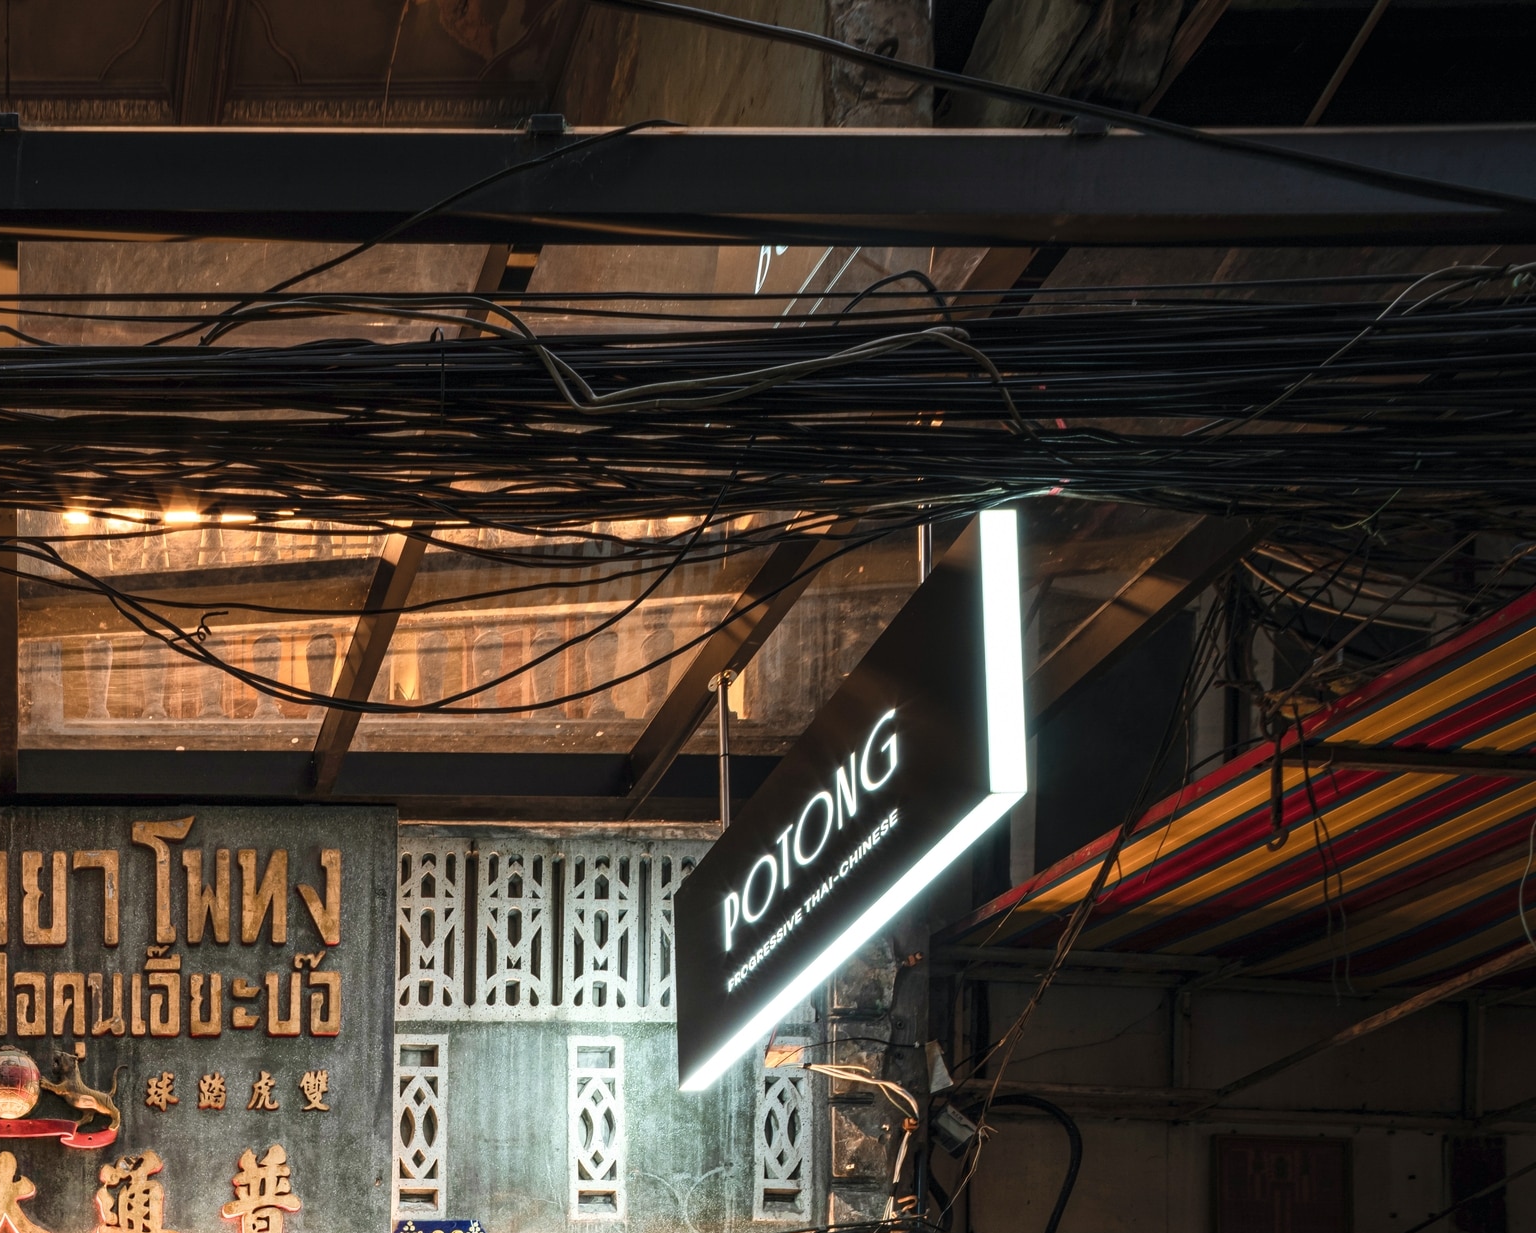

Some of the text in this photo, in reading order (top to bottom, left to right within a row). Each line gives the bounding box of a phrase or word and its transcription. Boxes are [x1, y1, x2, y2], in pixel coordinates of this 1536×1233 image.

[723, 708, 900, 952] POTONG
[727, 808, 900, 994] PROGRESSIVE THAI-CHINESE
